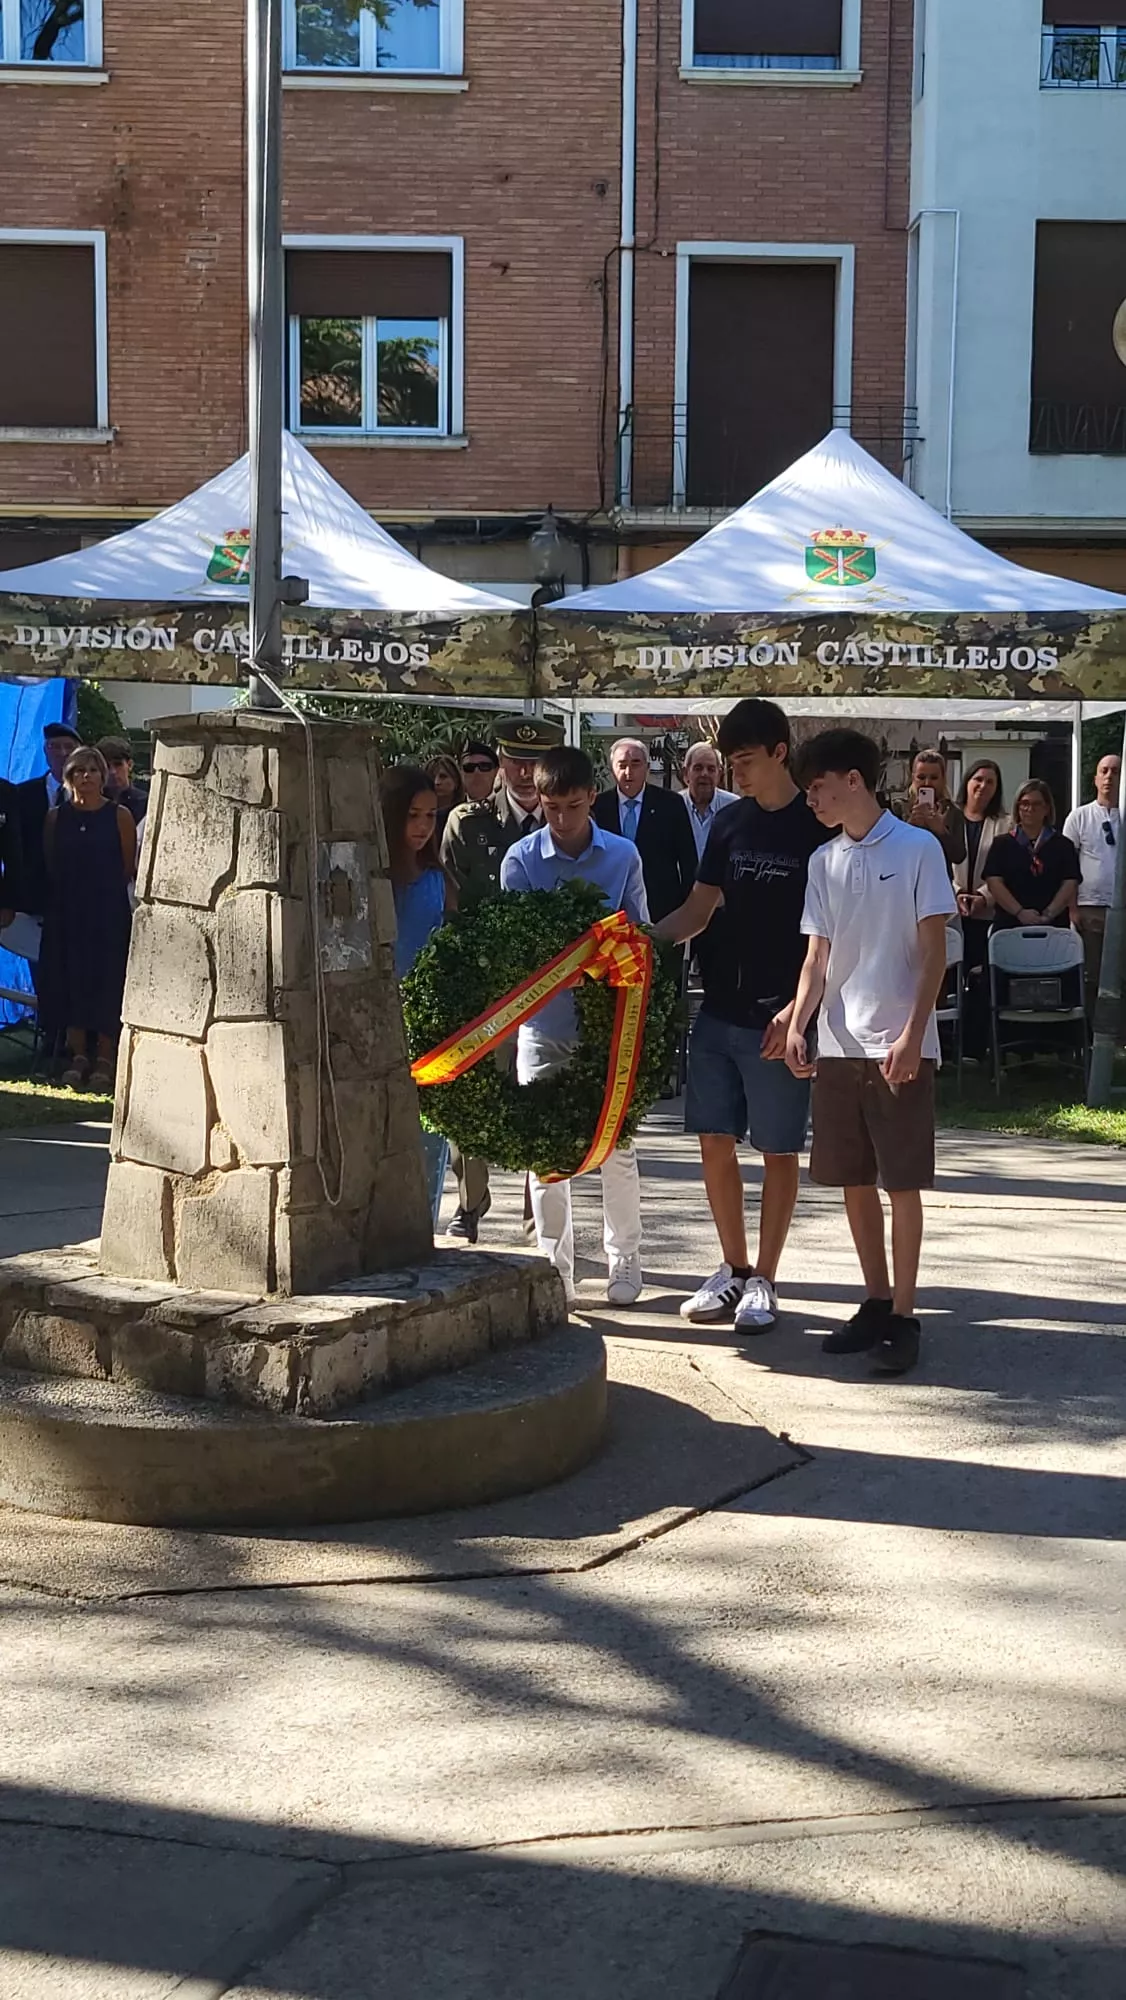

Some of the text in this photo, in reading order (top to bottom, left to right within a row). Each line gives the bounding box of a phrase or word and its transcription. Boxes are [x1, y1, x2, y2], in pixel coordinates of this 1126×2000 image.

[14, 618, 430, 665] DIVISIÓN CASILLEJOS
[636, 640, 1059, 671] DIVISIÓN CASTILLEJOS
